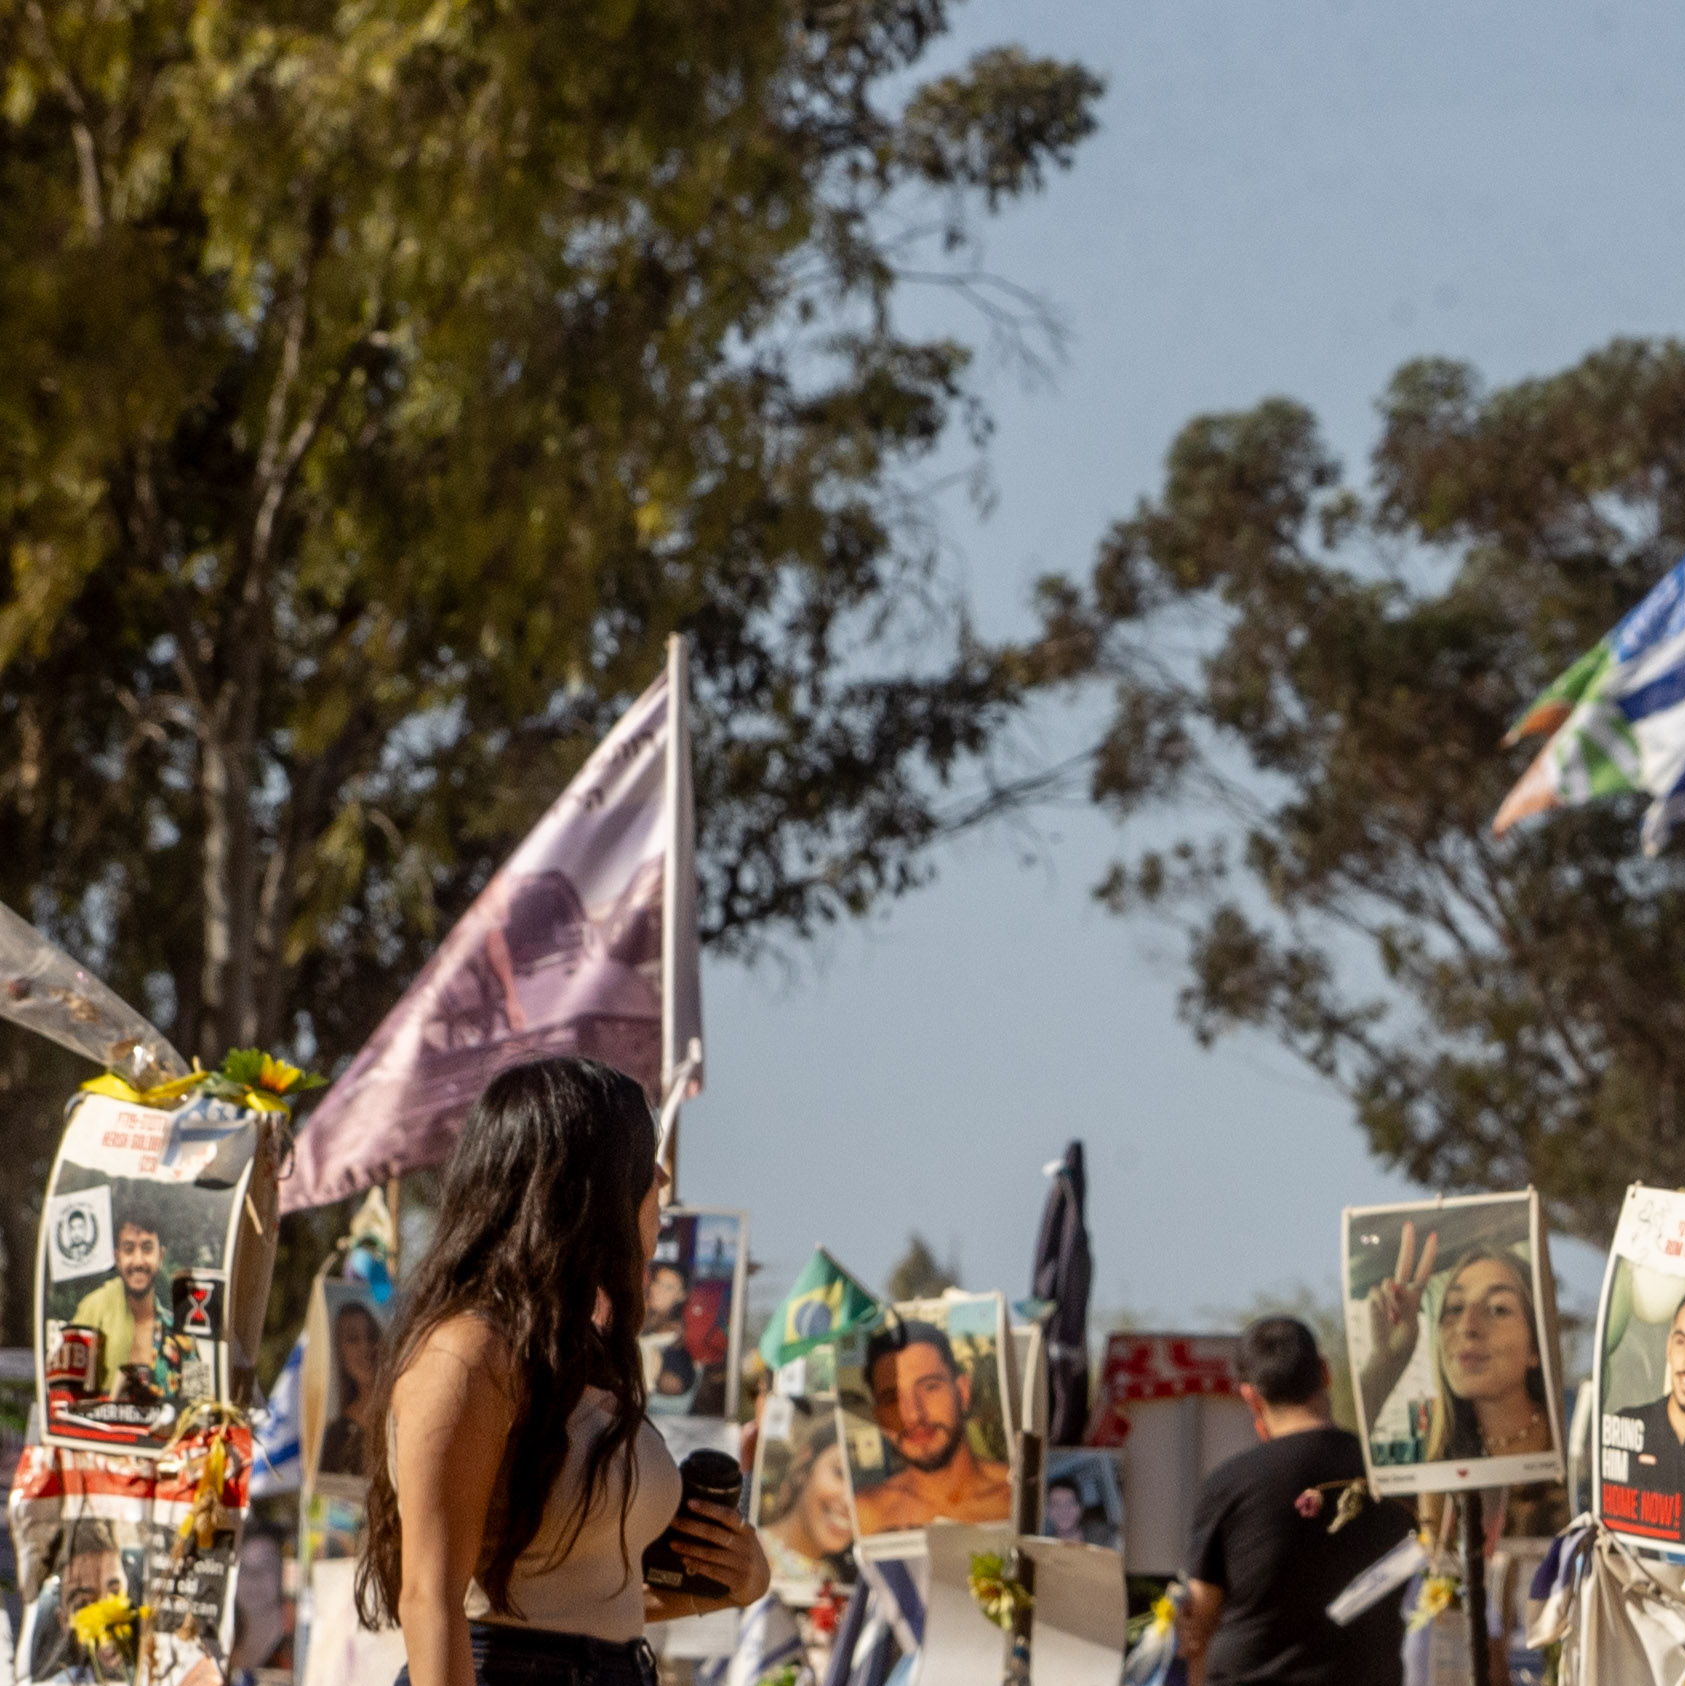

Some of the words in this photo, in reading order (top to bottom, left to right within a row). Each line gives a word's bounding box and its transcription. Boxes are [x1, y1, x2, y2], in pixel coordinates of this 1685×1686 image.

[1602, 1413, 1645, 1452] BRING
[1602, 1447, 1629, 1483] HIM
[1602, 1483, 1638, 1520] HOME
[1641, 1490, 1682, 1528] NOW!
